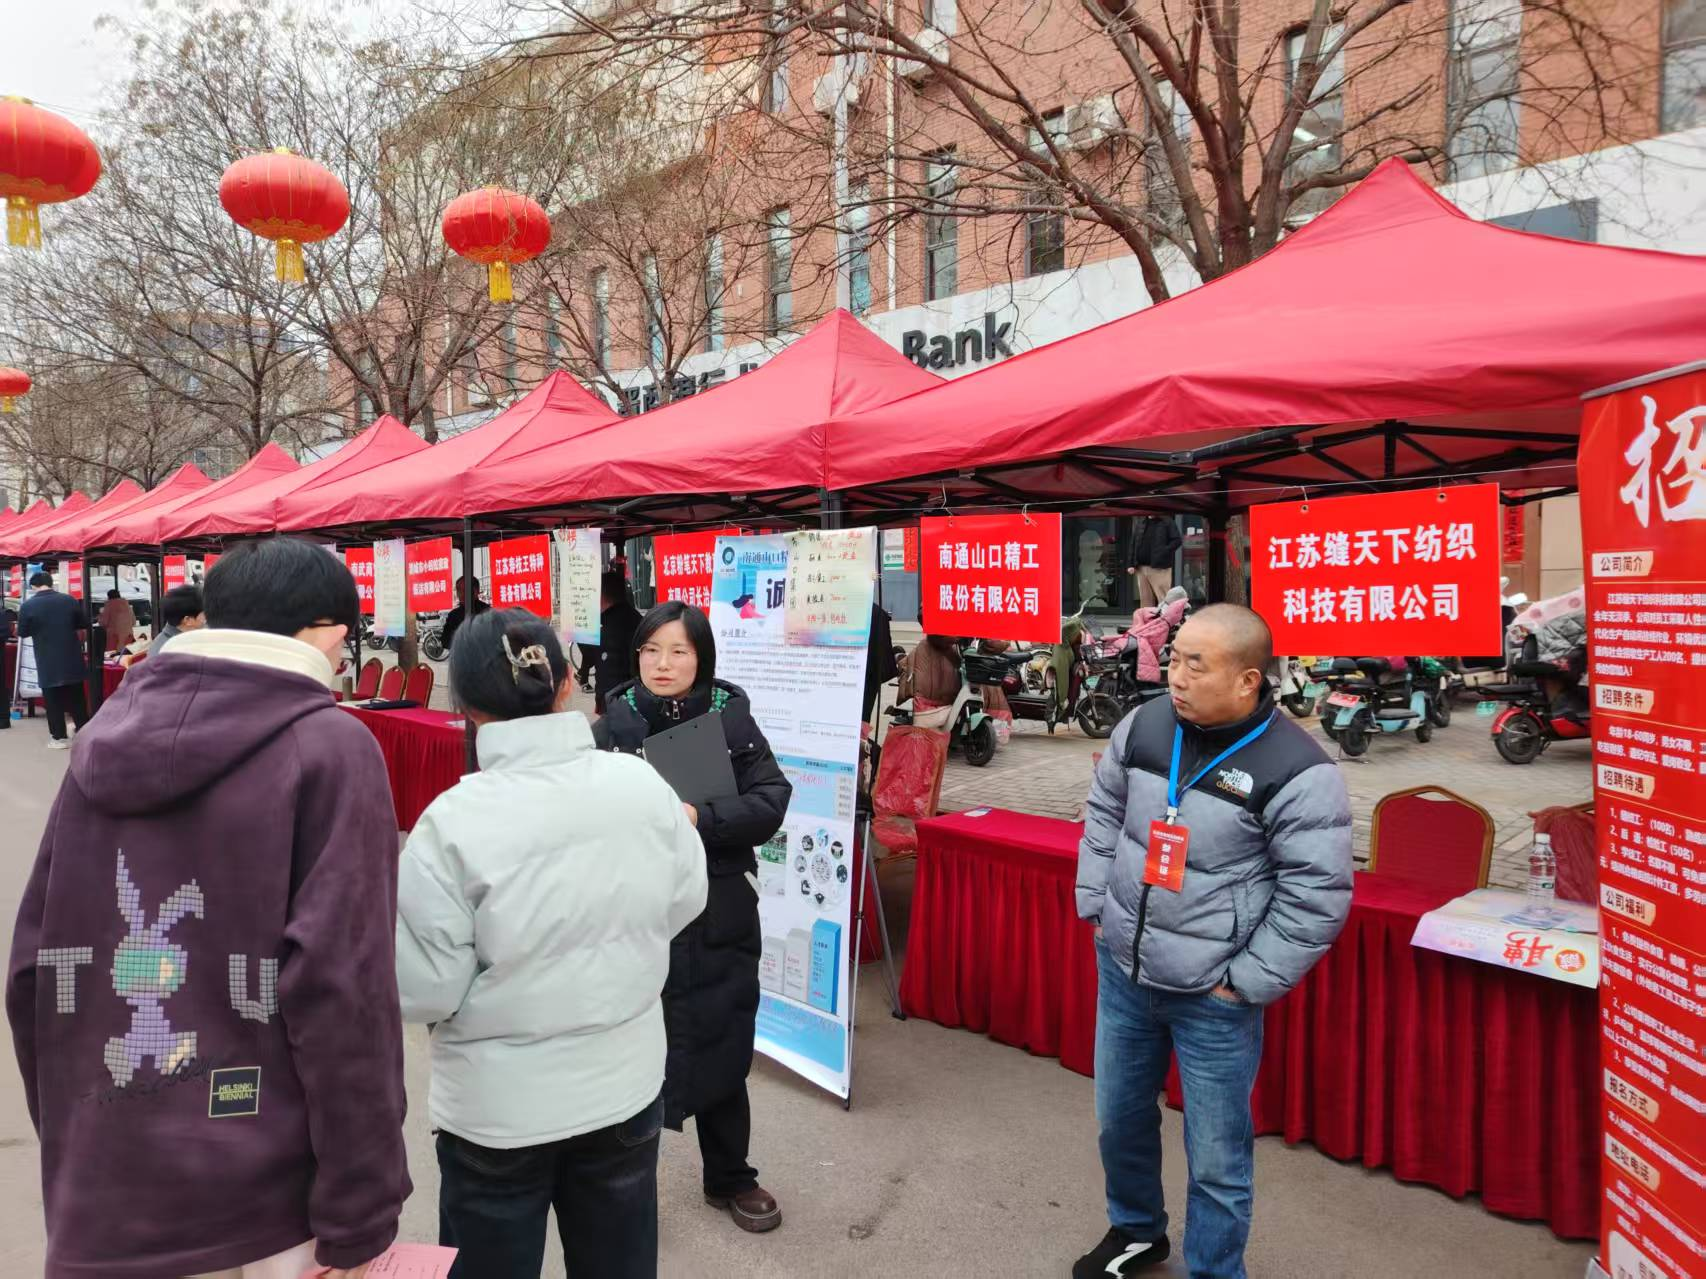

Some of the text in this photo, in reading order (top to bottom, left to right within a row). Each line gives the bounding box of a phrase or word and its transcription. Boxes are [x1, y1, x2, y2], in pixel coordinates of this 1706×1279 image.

[902, 312, 1014, 369] Bank
[938, 541, 1040, 571] 南通山口精工
[1267, 522, 1477, 570] 江苏缝天下纺织
[1600, 555, 1644, 572] 公司简介
[938, 584, 1039, 616] 股份有限公司
[1283, 583, 1459, 624] 科技有限公司
[1602, 688, 1644, 708] 招聘条件
[1603, 768, 1645, 794] 招聘待遇
[1605, 889, 1647, 920] 公司福利
[218, 1083, 254, 1093] HELSINKI
[1609, 1075, 1650, 1116] 报名方式
[1611, 1142, 1650, 1183] 地址电话
